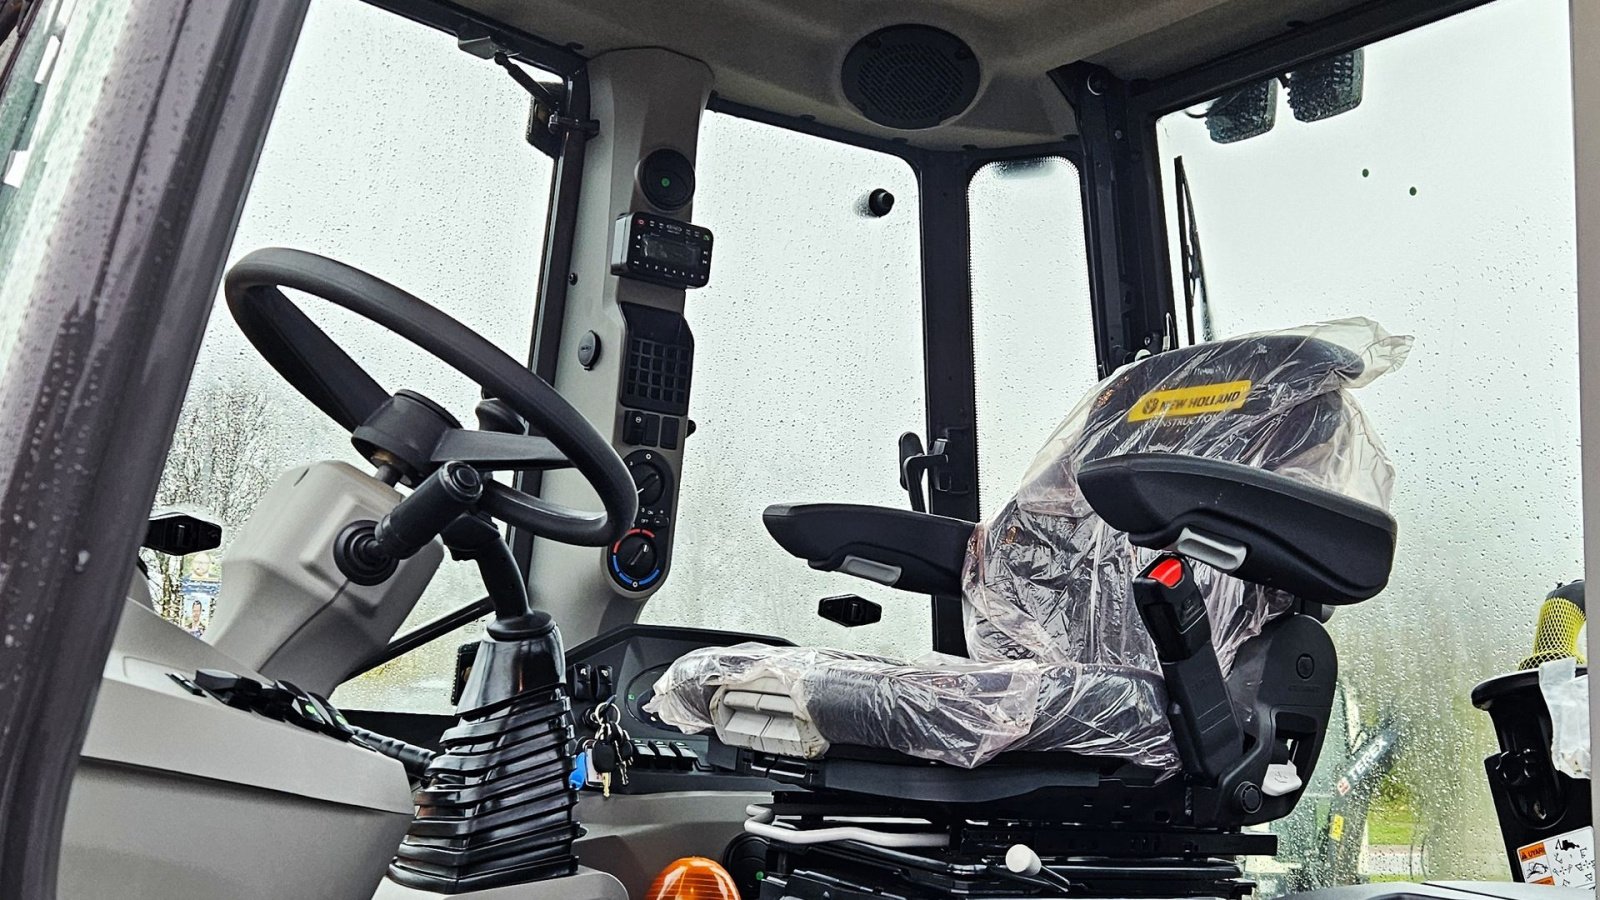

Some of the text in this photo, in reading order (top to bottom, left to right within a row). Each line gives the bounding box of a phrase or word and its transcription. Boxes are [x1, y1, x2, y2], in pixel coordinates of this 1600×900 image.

[1159, 391, 1241, 411] NEW HOLLAND
[1348, 735, 1388, 781] TEREX
